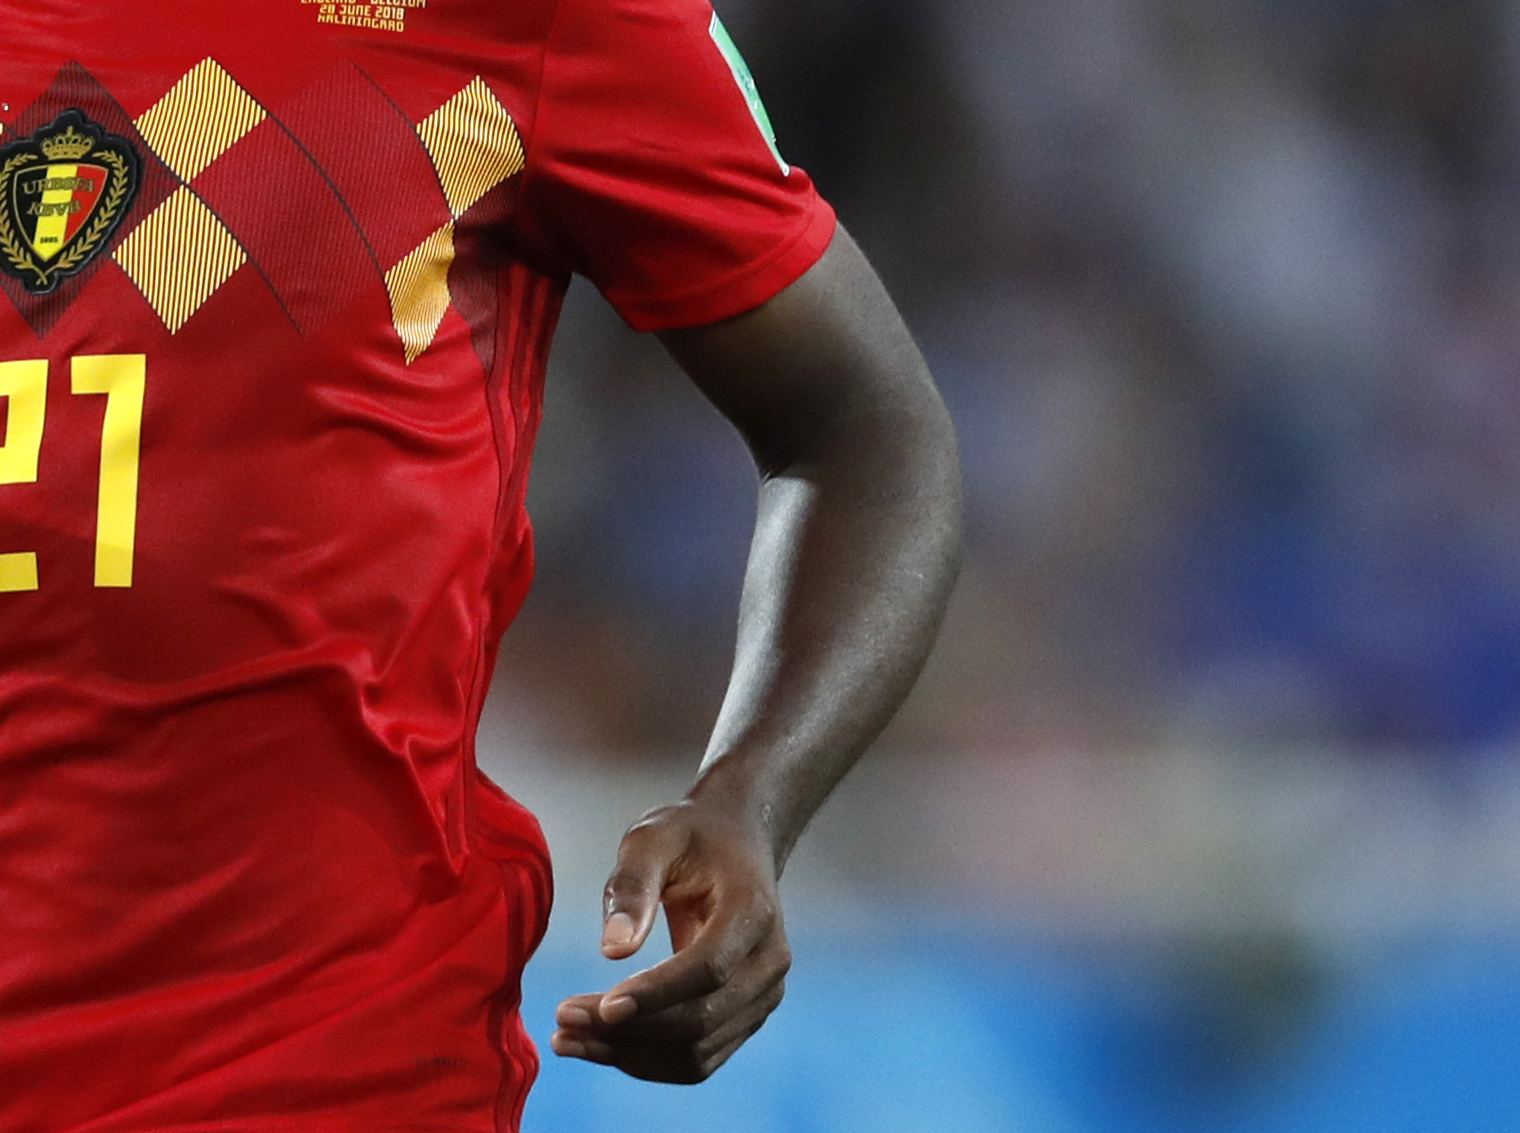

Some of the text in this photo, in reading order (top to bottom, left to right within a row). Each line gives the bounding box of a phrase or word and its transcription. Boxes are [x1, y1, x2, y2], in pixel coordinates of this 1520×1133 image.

[319, 4, 405, 20] 28 JUNE 2018
